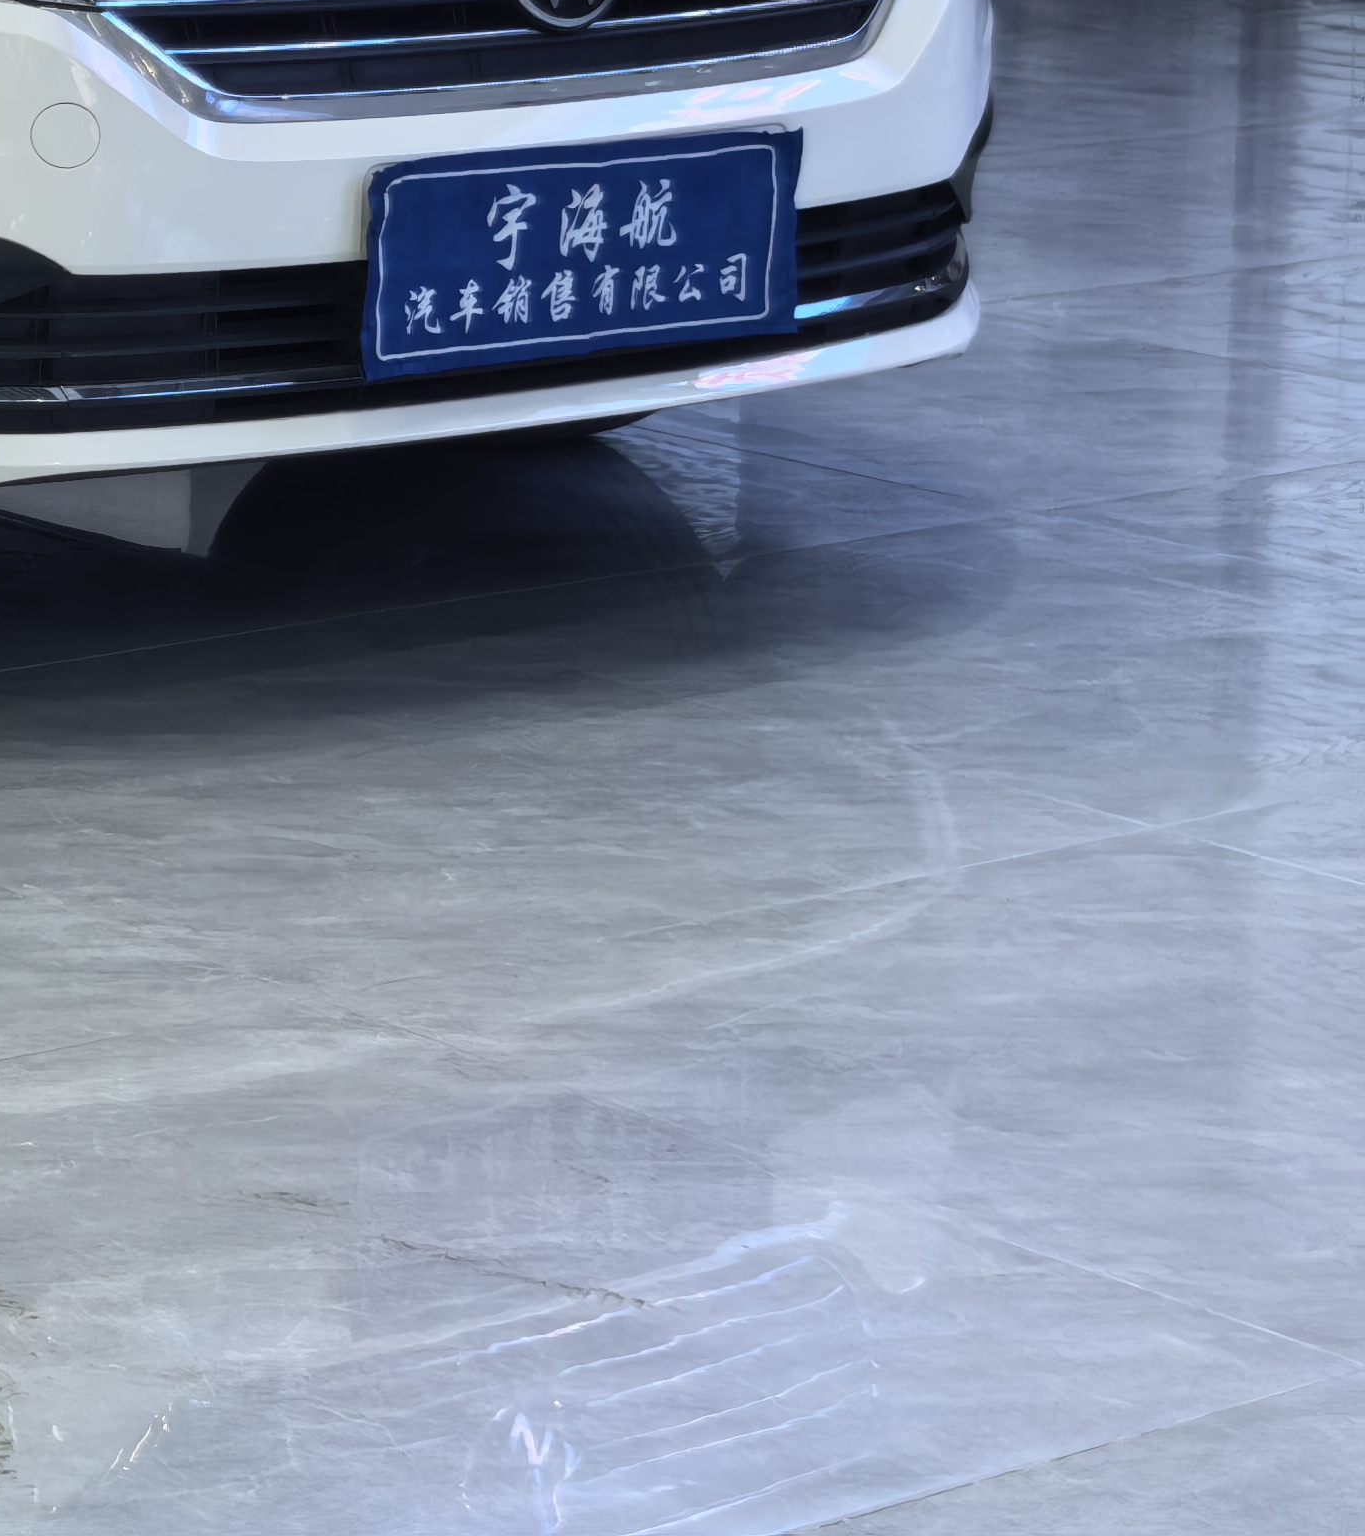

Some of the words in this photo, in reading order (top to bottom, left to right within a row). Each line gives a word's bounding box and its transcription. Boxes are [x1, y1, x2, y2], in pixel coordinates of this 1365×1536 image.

[486, 178, 678, 270] 宇海航
[404, 252, 747, 335] 汽车销售有限公司
